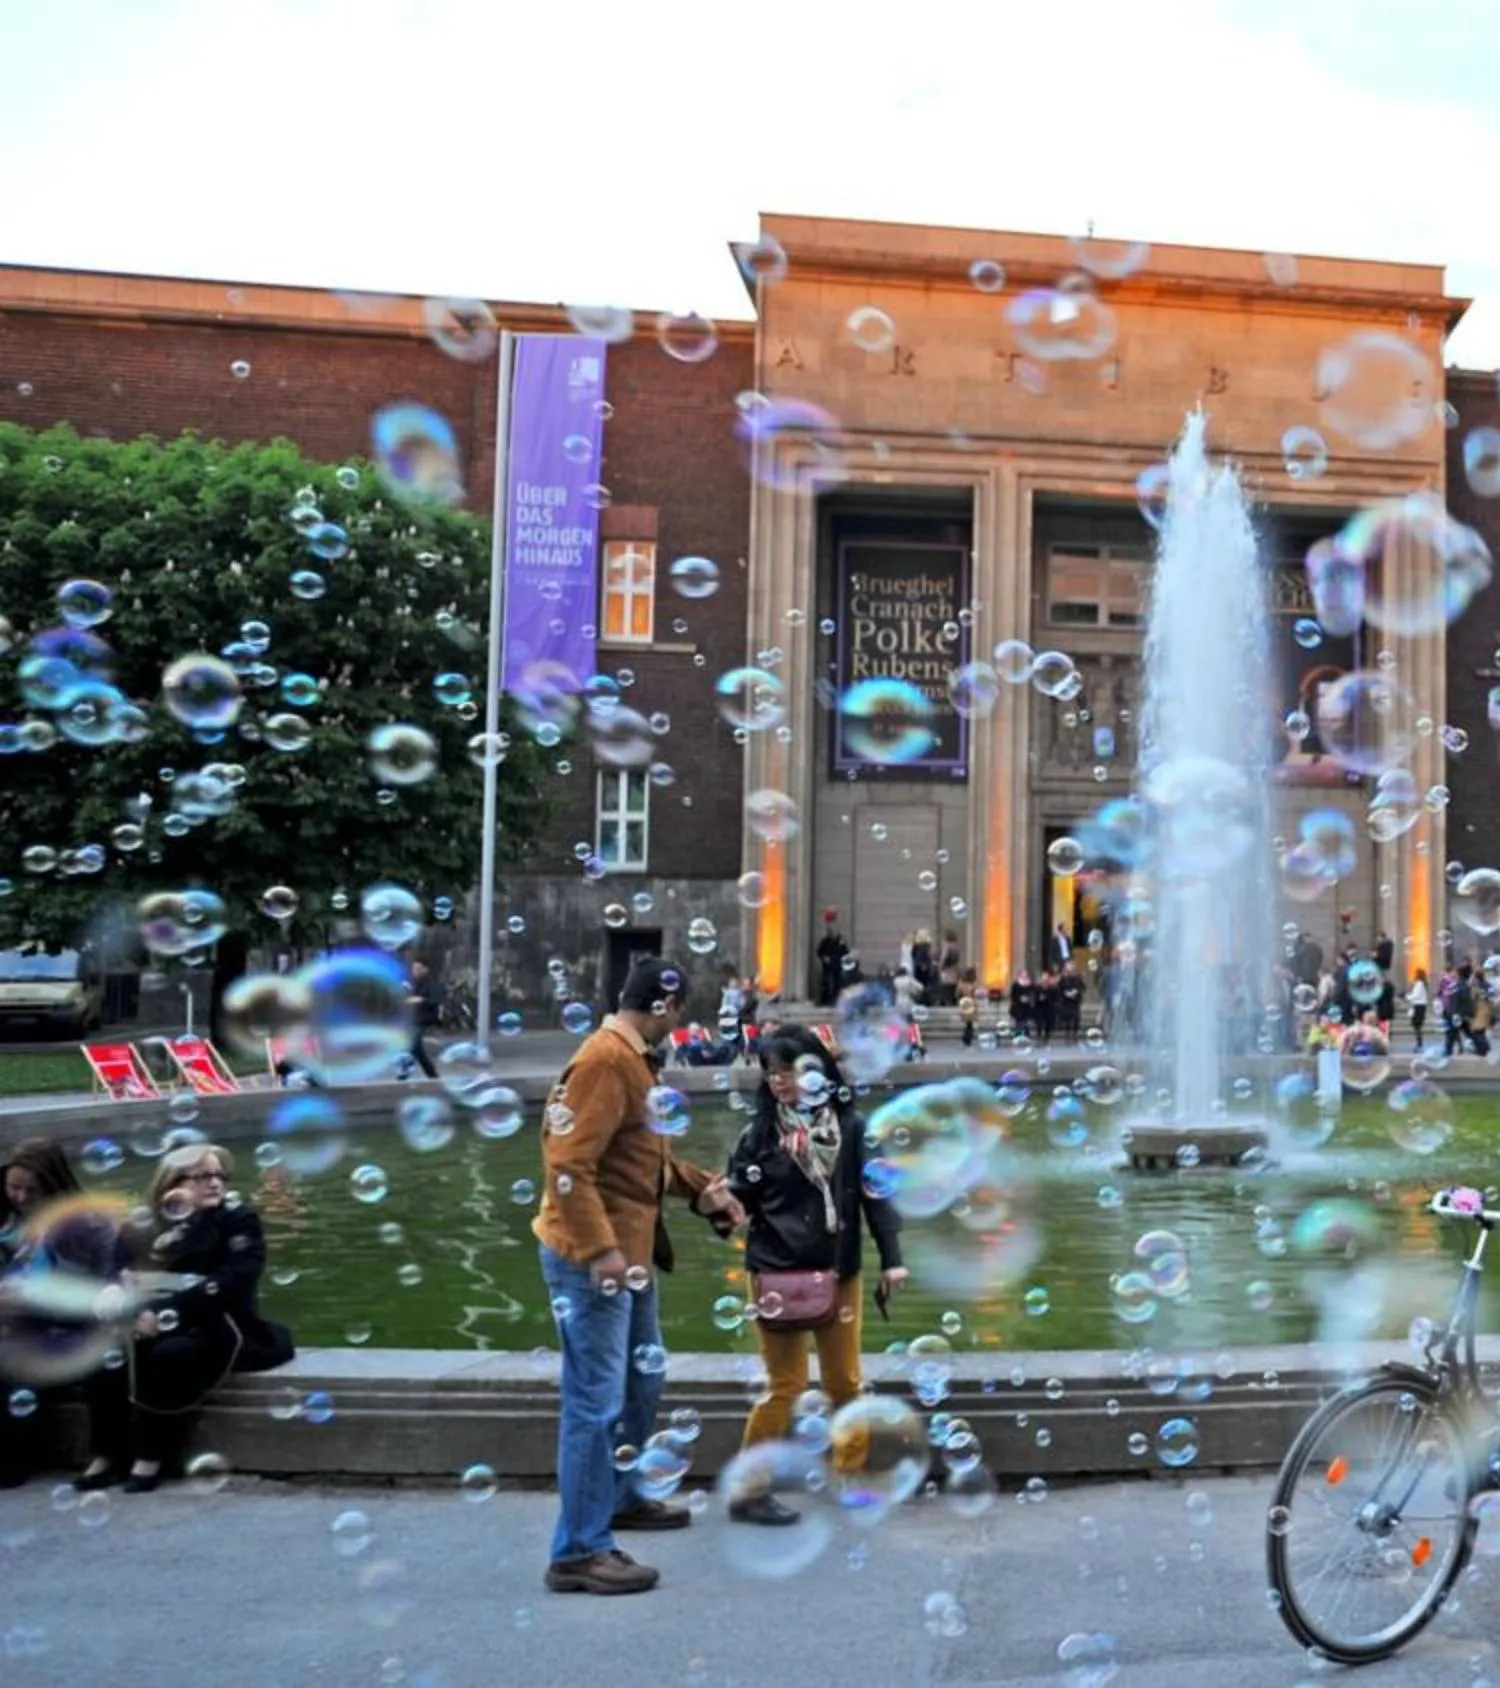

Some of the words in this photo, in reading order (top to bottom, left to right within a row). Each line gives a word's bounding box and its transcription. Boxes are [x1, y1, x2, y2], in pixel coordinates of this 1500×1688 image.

[776, 338, 1424, 399] ARTIB
[516, 480, 567, 507] ÜBER
[516, 506, 553, 526] DAS
[516, 526, 592, 547] MORGEN
[516, 547, 583, 566] HINAUS
[852, 572, 954, 598] Brueghel
[851, 595, 954, 620] Cranach
[853, 619, 954, 654] Polke
[852, 653, 954, 680] Rubens
